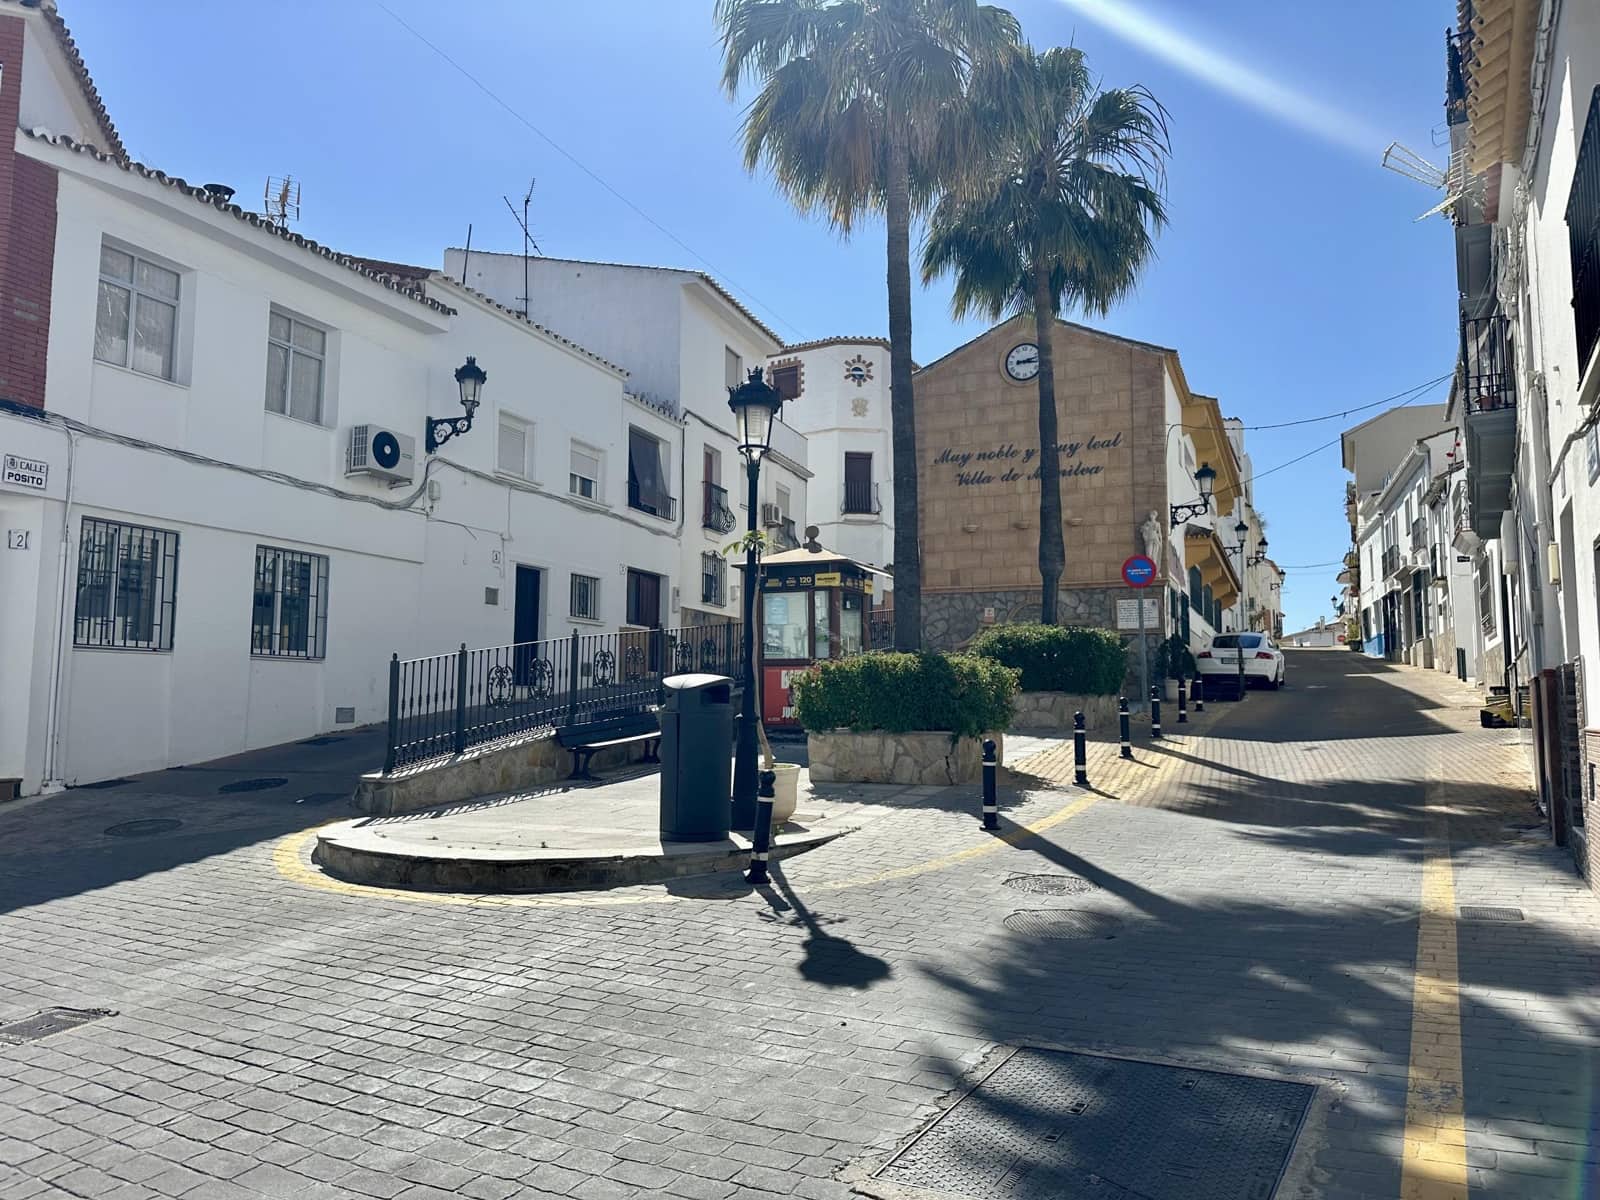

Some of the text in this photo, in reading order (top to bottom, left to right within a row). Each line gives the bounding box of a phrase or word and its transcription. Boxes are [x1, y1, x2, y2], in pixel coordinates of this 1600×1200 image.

[934, 447, 974, 467] Muy
[976, 444, 1020, 460] noble
[1022, 448, 1039, 463] y
[1086, 431, 1123, 449] leal
[20, 461, 45, 473] CALLE
[955, 461, 1104, 486] Villa de Mnilva
[7, 471, 43, 486] POSITO
[16, 534, 24, 547] 2
